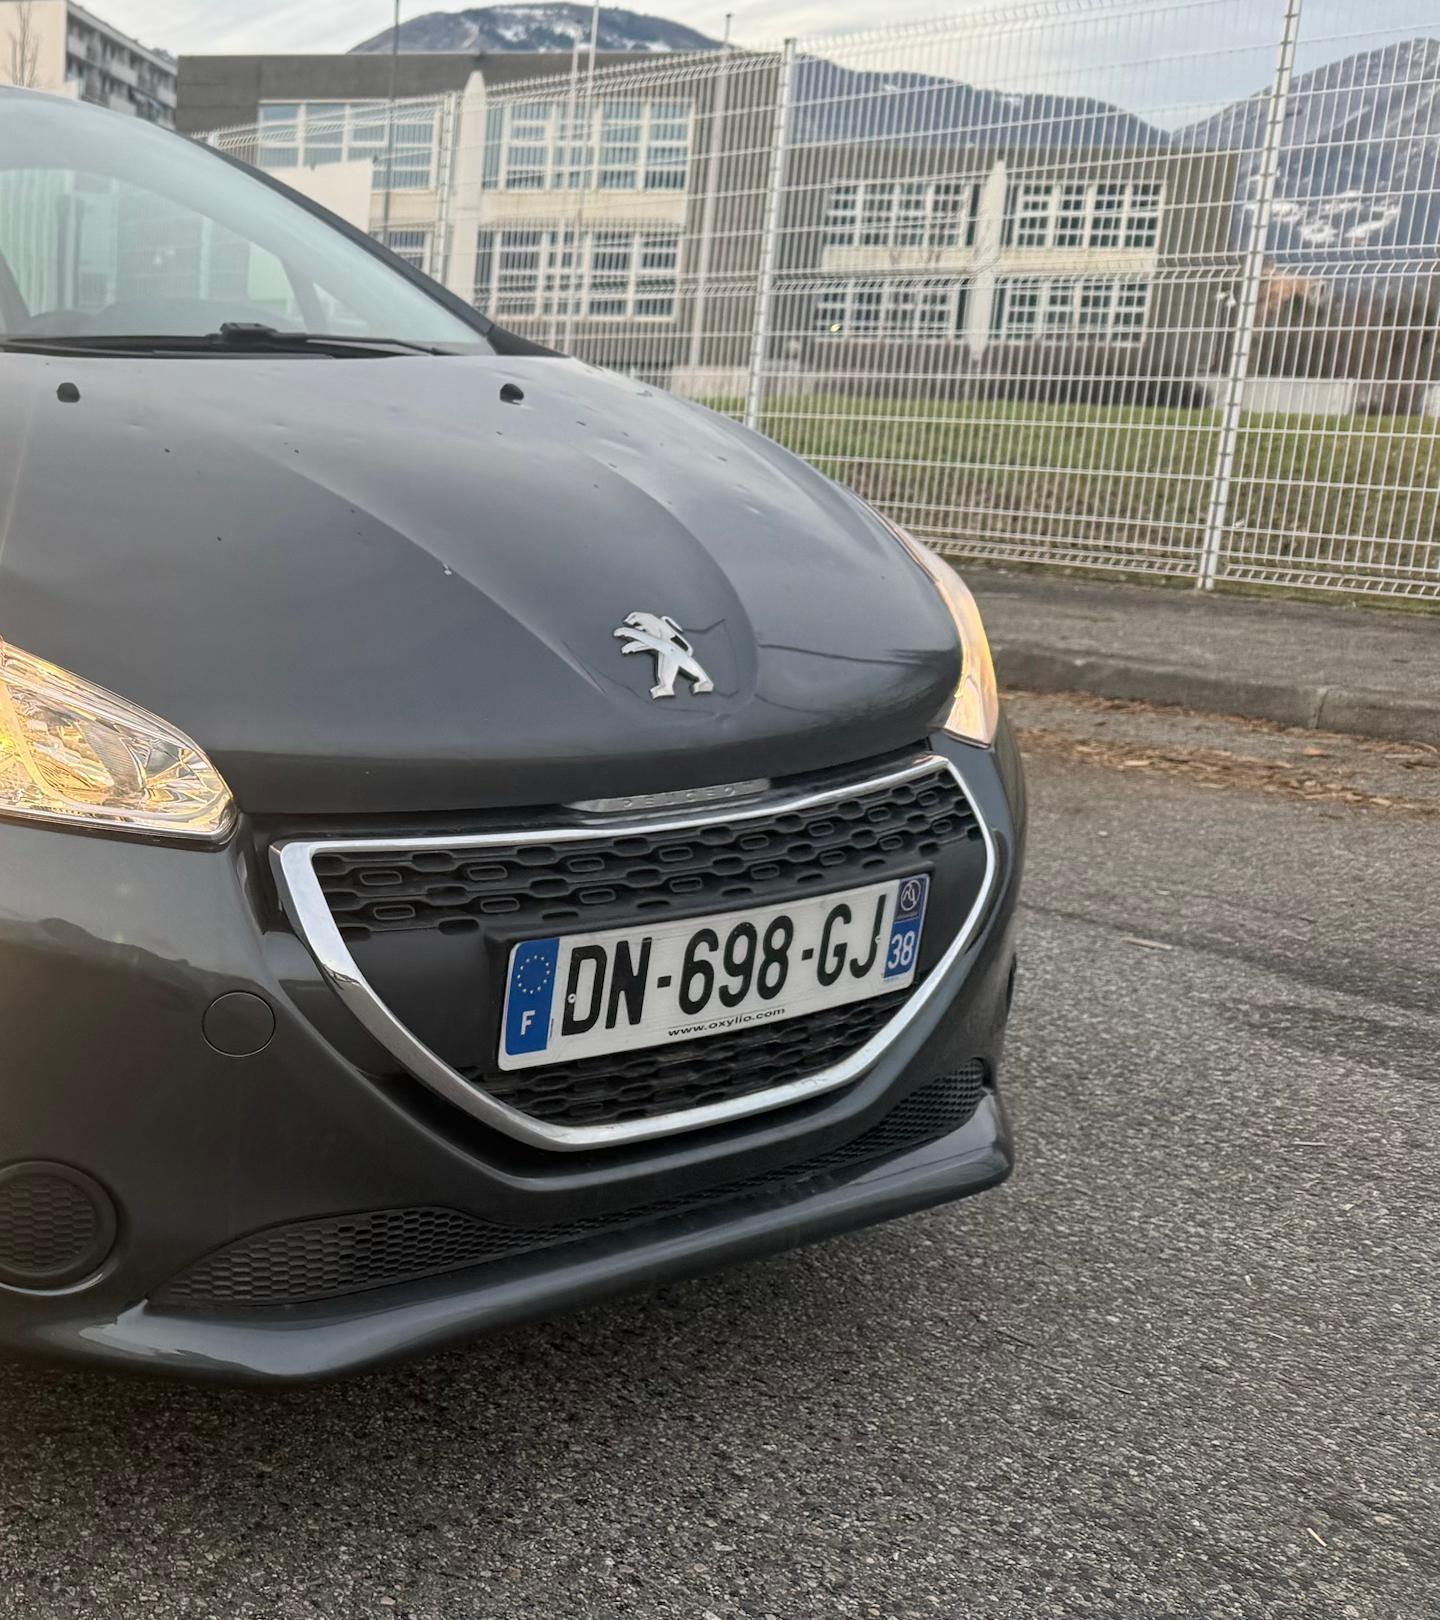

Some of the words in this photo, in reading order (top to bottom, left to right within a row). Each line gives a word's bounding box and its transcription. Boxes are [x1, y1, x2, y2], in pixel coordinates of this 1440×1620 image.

[561, 894, 887, 1036] DN-698-GJ
[887, 930, 915, 970] 38
[520, 1010, 537, 1036] F
[668, 1008, 785, 1036] www.oxylio.com
